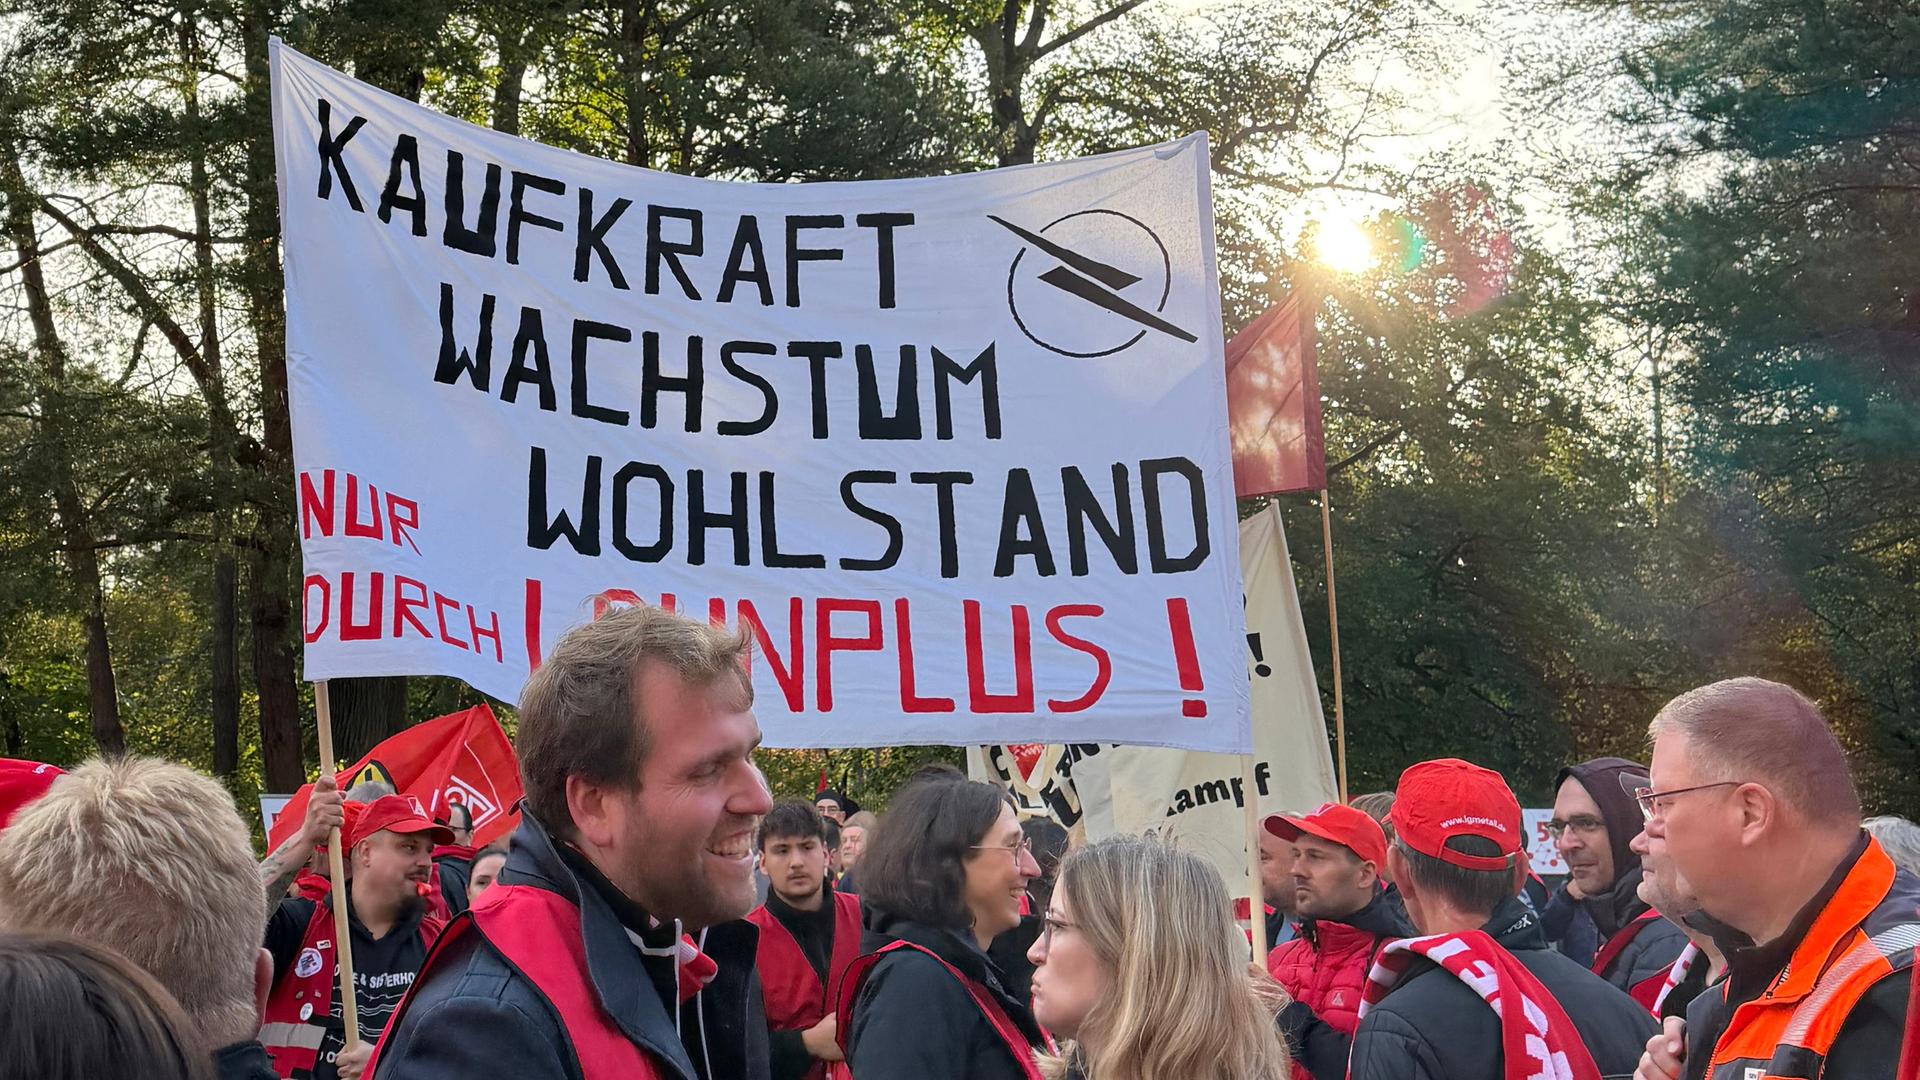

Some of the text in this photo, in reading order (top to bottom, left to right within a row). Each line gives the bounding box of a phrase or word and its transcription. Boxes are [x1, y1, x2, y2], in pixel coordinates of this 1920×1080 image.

[317, 98, 915, 310] KAUFKRAFT
[434, 282, 1002, 440] WACHSTUM
[300, 469, 423, 557] NUR
[527, 446, 1211, 578] WOHLSTAND
[304, 571, 503, 664] DURCH
